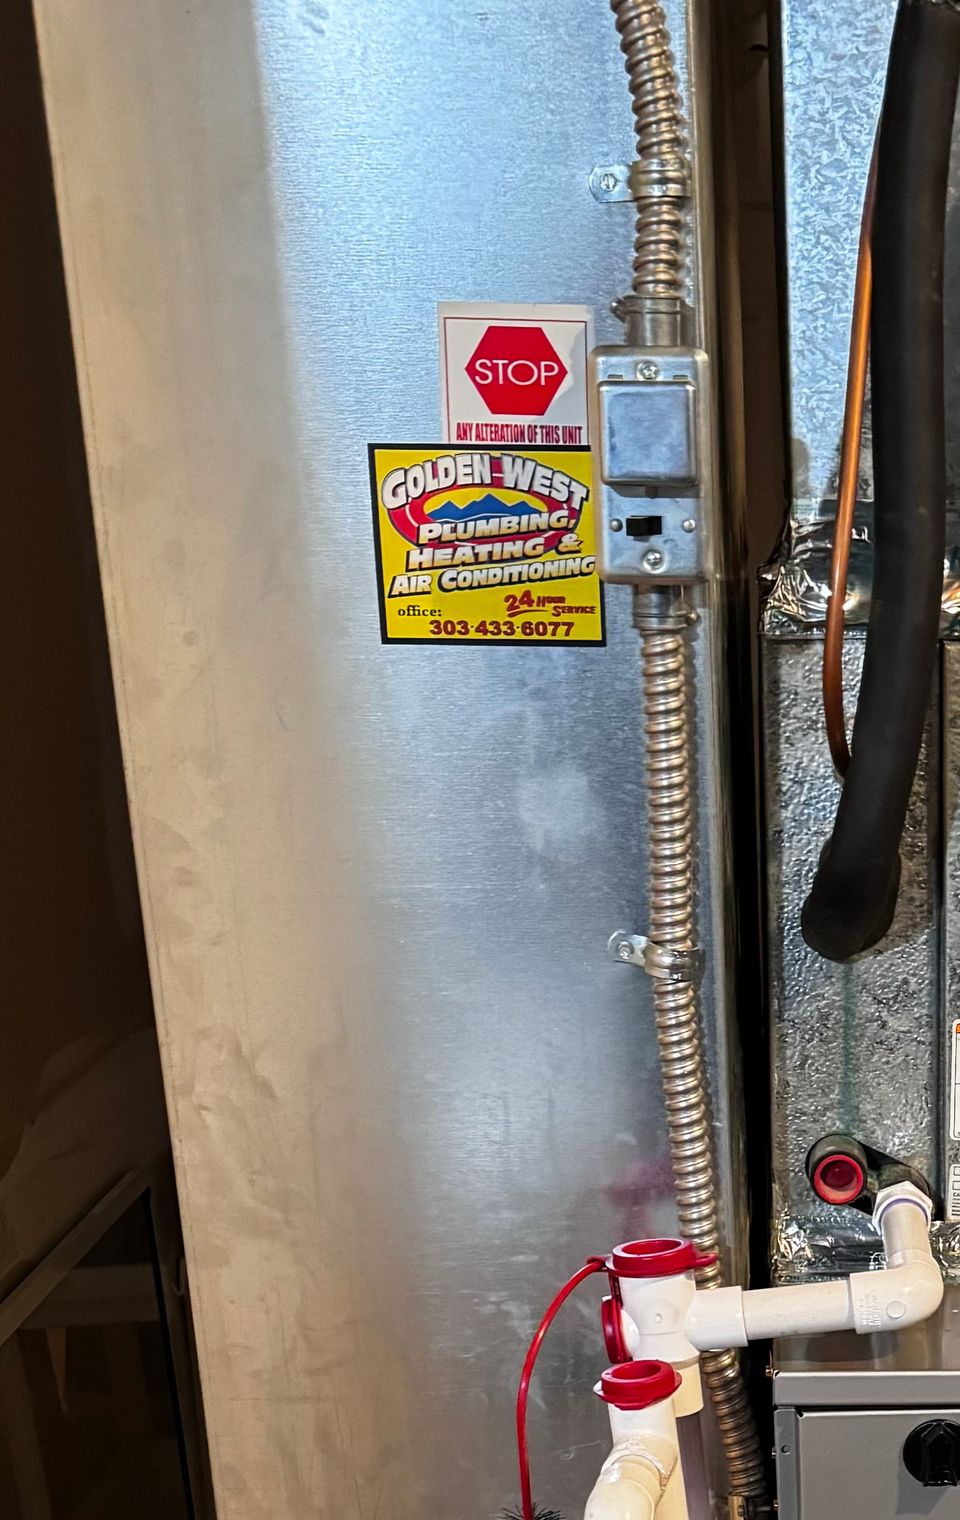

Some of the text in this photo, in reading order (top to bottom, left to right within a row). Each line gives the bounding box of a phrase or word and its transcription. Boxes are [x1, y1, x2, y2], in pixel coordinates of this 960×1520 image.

[474, 359, 559, 386] STOP
[456, 422, 583, 444] ANY ALTERATION OF THIS UNIT
[381, 453, 590, 511] GOLDEN WEST
[406, 534, 584, 571] HEATING &
[397, 605, 442, 617] office:
[504, 590, 535, 611] 24
